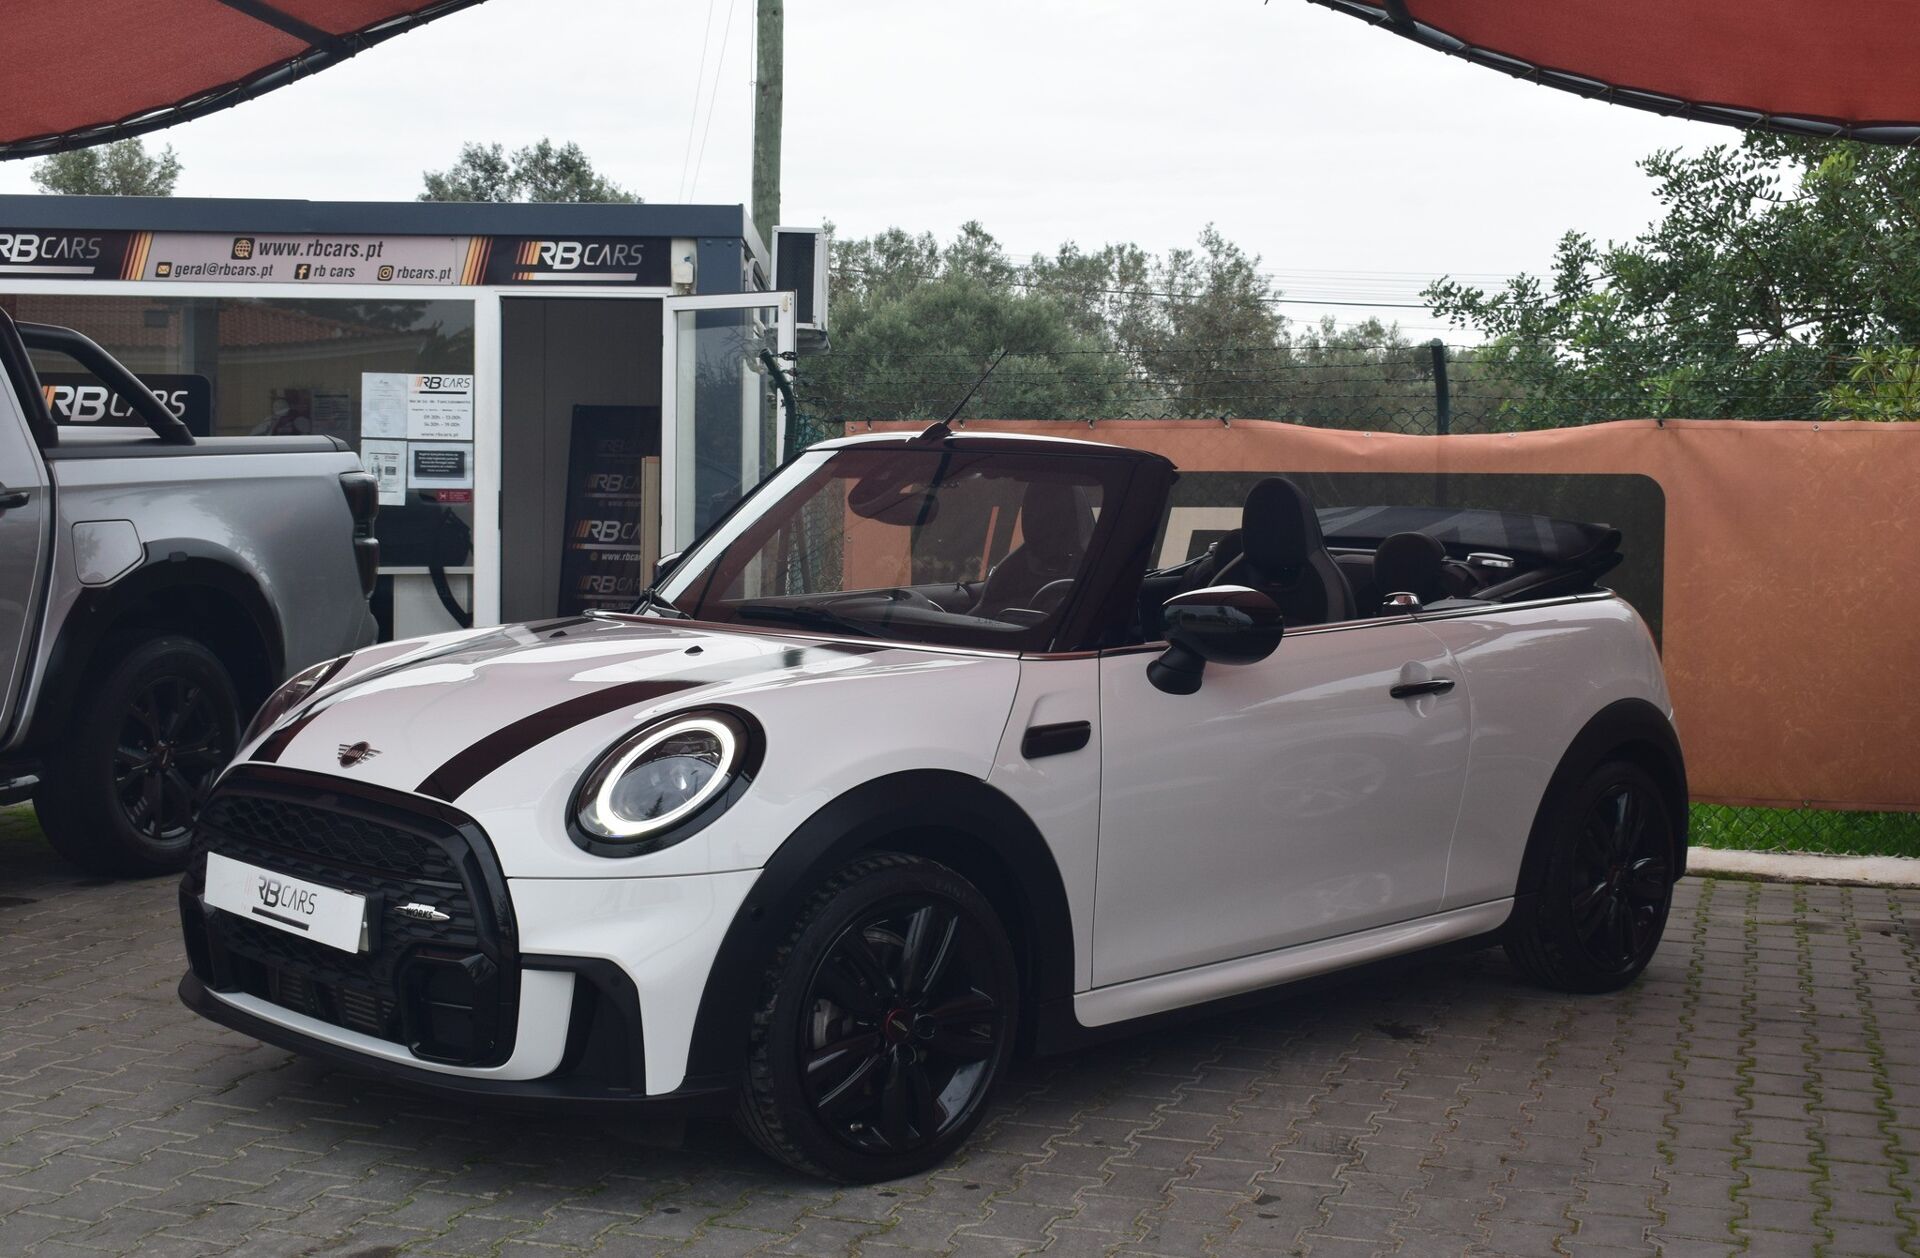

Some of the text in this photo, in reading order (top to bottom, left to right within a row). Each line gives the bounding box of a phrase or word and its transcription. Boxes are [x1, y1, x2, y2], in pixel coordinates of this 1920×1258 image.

[259, 239, 384, 261] www.rbcars.pt
[174, 262, 274, 278] geral@rbcars.pt
[313, 264, 356, 278] rb cars
[396, 266, 452, 281] rbcars.pt
